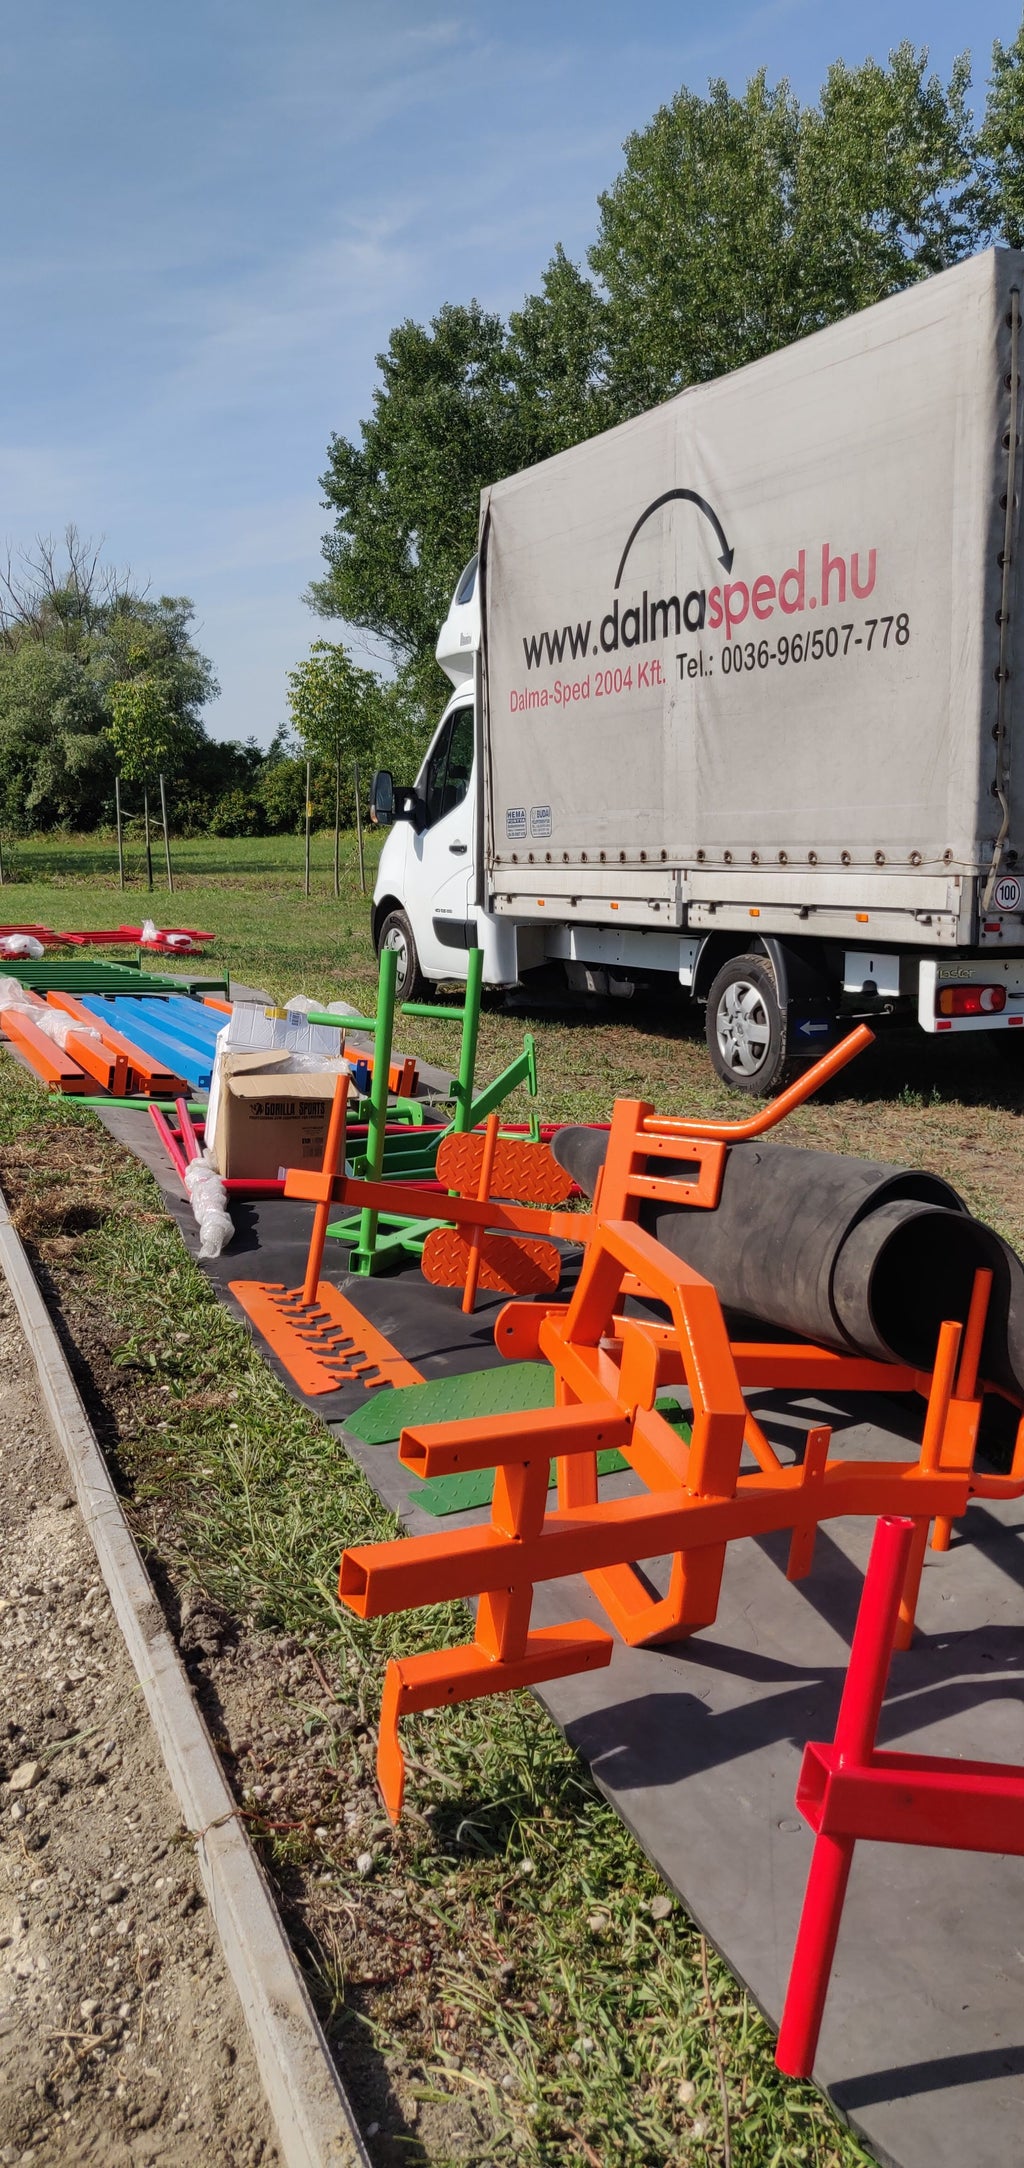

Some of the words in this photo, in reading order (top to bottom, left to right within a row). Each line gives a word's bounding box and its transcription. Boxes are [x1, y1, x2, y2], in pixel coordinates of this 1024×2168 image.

[522, 542, 877, 671] www.dalmasped.hu
[676, 650, 713, 680] Tel.:
[721, 612, 910, 675] 0036-96/507-778
[510, 674, 590, 713] Dalma-Sped
[594, 665, 633, 697] 2004
[637, 659, 666, 689] Kft.
[999, 884, 1016, 901] 100
[264, 1102, 296, 1116] GORILLA
[299, 1101, 326, 1116] SPORTS
